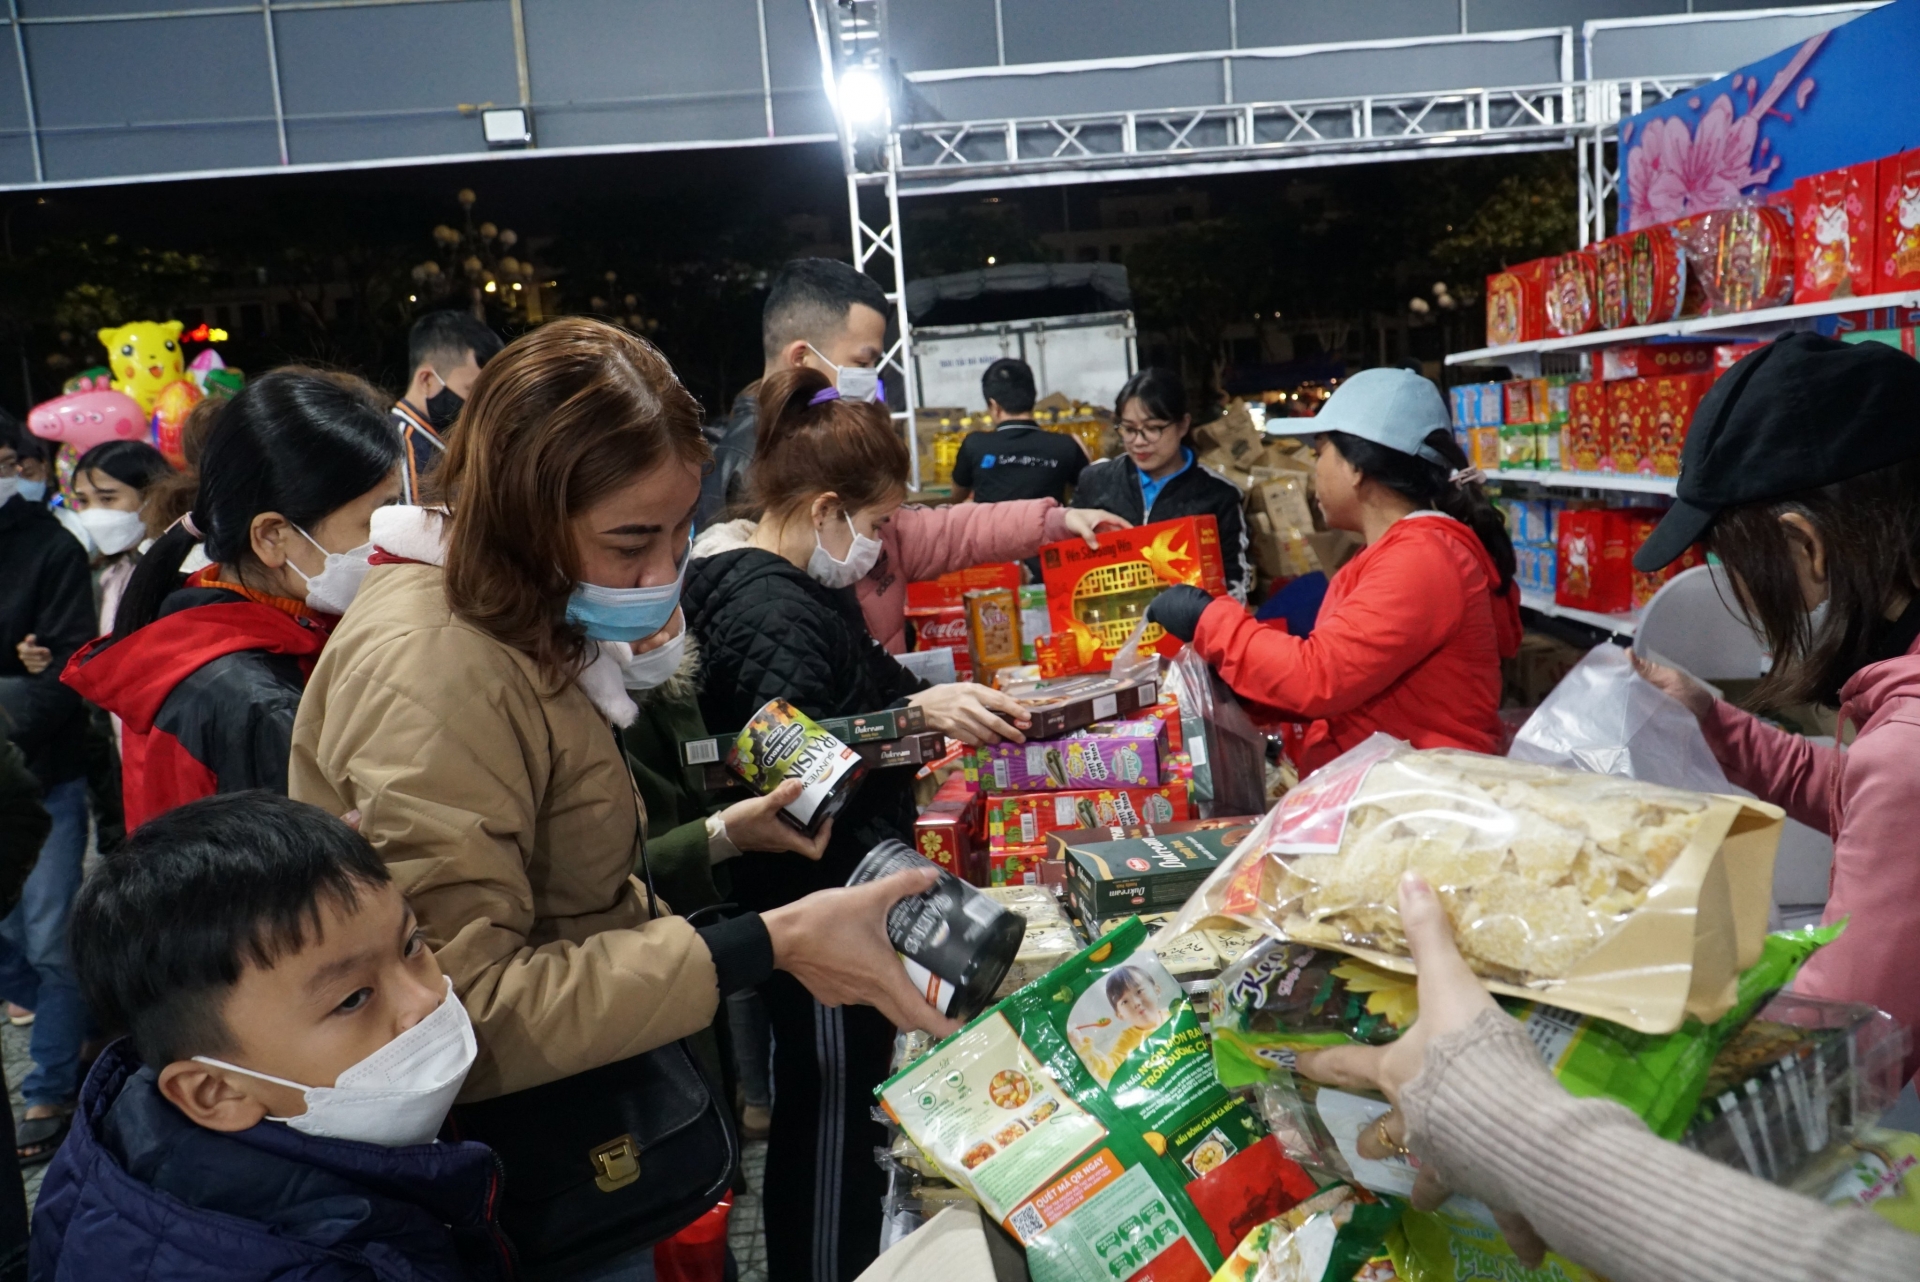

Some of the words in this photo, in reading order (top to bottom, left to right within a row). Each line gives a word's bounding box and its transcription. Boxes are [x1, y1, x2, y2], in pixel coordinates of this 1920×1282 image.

[781, 723, 803, 747] SEEDLESS
[855, 725, 884, 734] Dukream
[764, 743, 784, 765] MEDLEY
[881, 750, 911, 759] Dukream
[800, 751, 835, 791] SUNVIEW
[1142, 837, 1187, 868] Dukream
[1109, 887, 1145, 897] Dukream
[1234, 950, 1287, 1008] Kẹo
[1128, 1074, 1141, 1086] NẤU
[1142, 1063, 1168, 1089] TRÒN
[1035, 1188, 1057, 1208] QUÉT
[1056, 1177, 1071, 1192] MÃ
[1071, 1171, 1084, 1185] QR
[1083, 1157, 1104, 1174] NGAY
